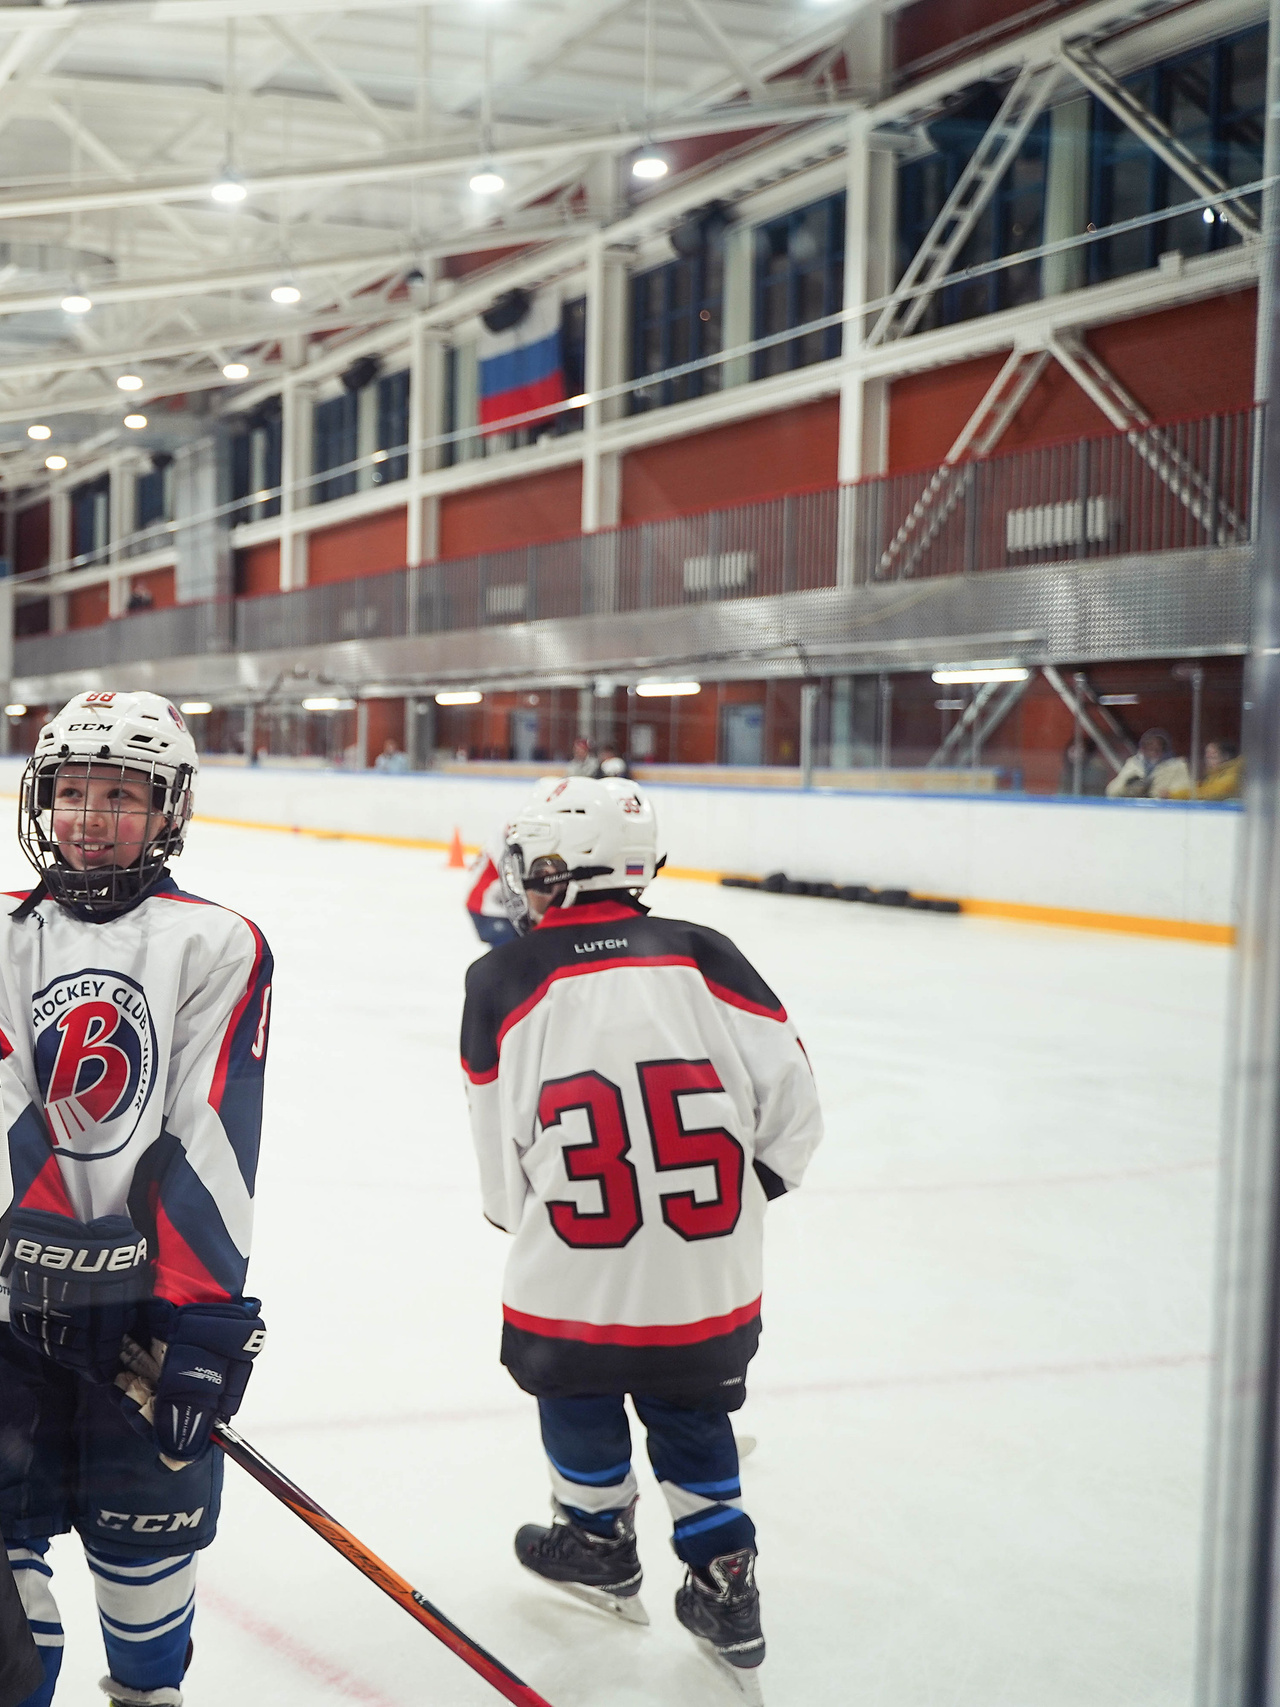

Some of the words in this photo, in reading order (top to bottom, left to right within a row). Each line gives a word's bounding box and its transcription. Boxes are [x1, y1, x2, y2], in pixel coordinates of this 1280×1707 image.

[68, 723, 114, 732] CCM
[573, 937, 629, 954] LUTCH
[32, 980, 106, 1028] HOCKEY
[538, 1058, 744, 1249] 35
[14, 1237, 148, 1273] BAUER
[96, 1506, 205, 1533] CCM
